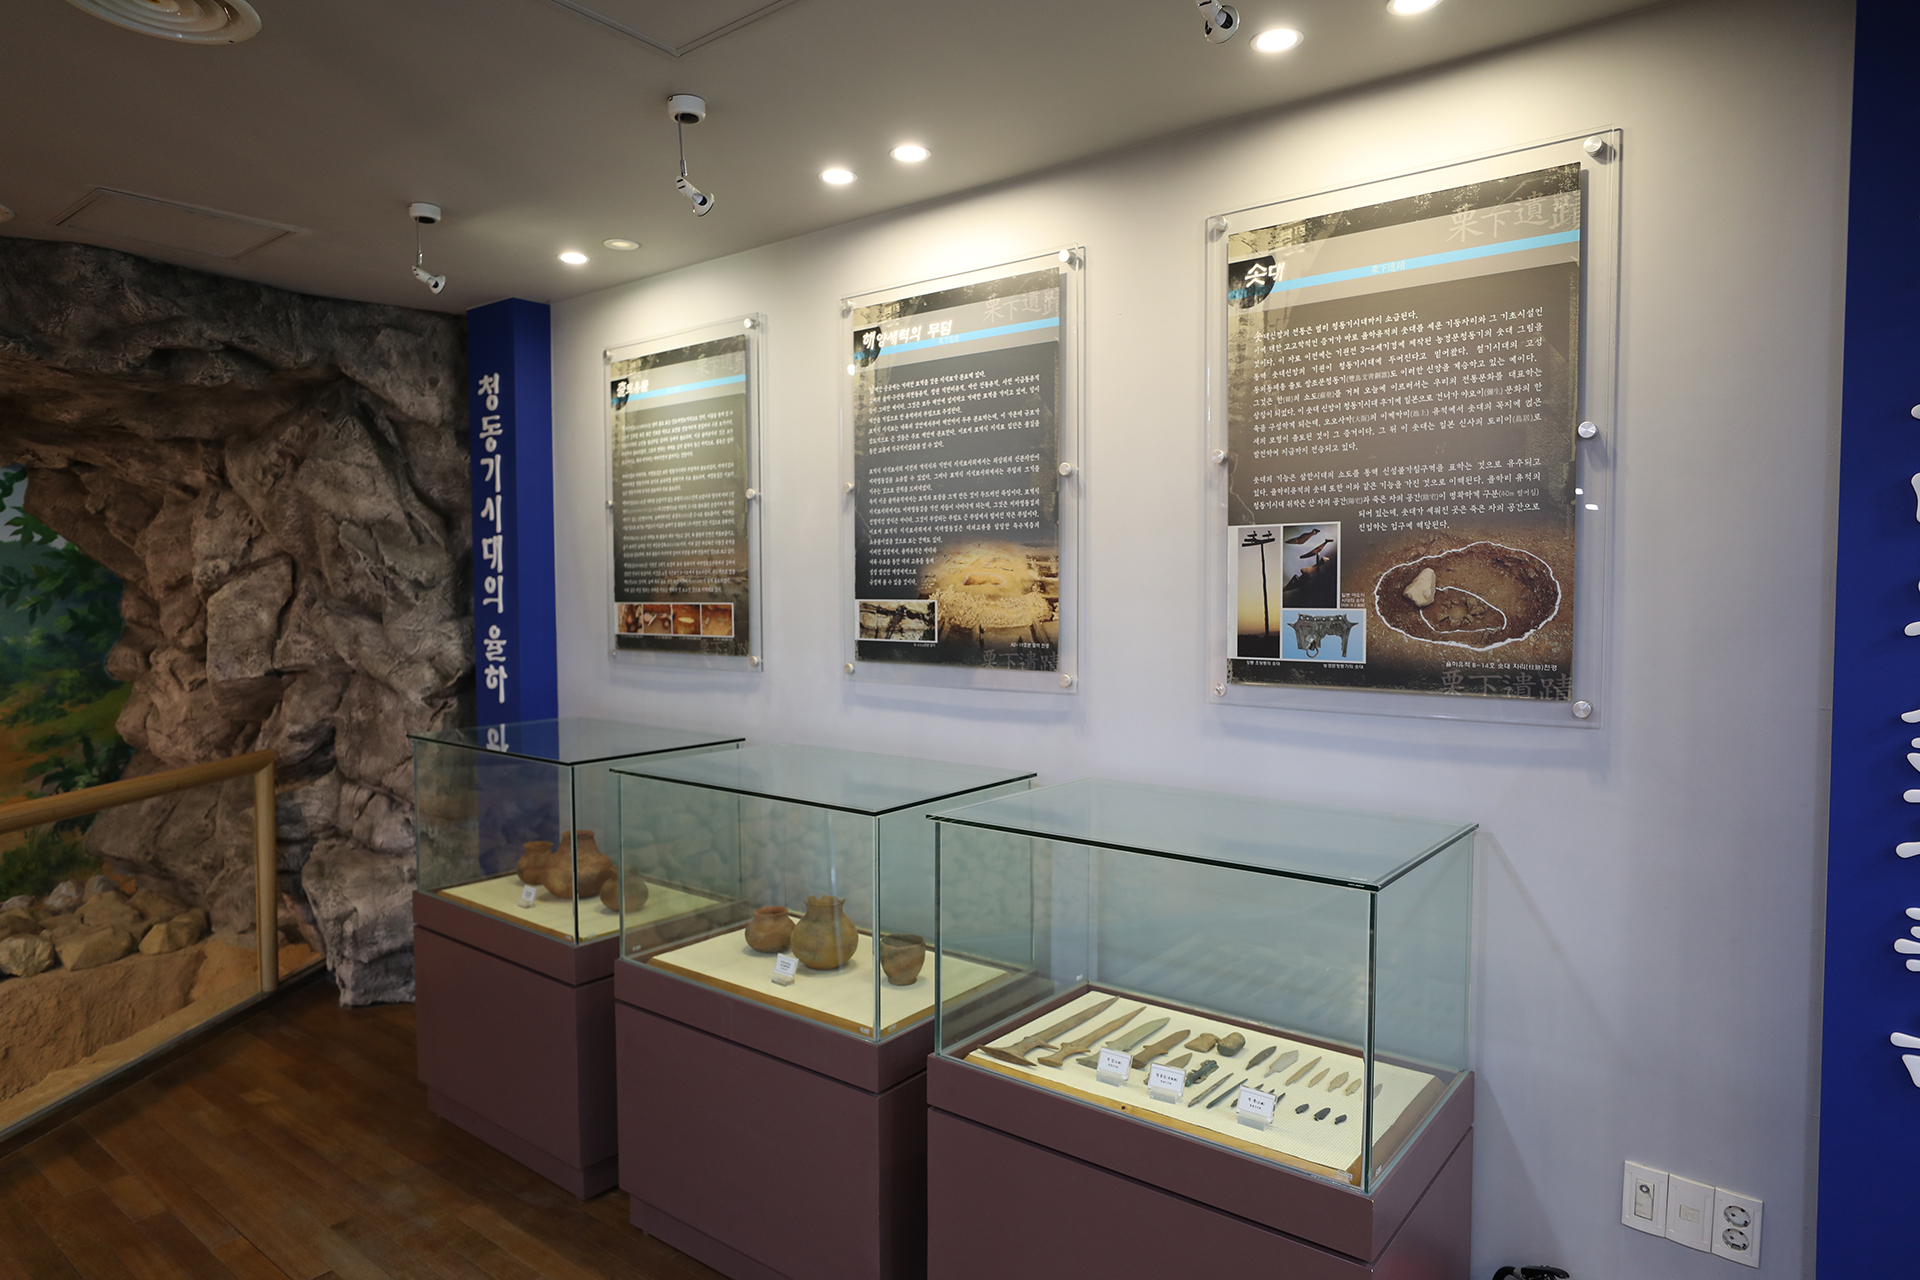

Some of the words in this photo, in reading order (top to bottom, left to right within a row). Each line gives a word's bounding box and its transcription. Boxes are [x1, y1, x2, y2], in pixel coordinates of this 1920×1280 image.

[1244, 262, 1284, 288] 솟대
[862, 326, 922, 351] 해양세력의
[927, 320, 953, 339] 무덤
[1252, 328, 1290, 343] 솟대신앙의
[1291, 325, 1313, 337] 전통은
[1314, 322, 1329, 334] 멀리
[1331, 314, 1382, 331] 청동기시대까지
[1384, 309, 1419, 323] 소급된다.
[1253, 345, 1267, 355] 이에
[1268, 342, 1283, 353] 대한
[1283, 337, 1318, 351] 고고학적인
[1319, 333, 1342, 346] 증거가
[1343, 332, 1359, 343] 바로
[1360, 326, 1398, 341] 율하유적의
[1400, 322, 1424, 335] 솟대를
[1426, 320, 1443, 331] 세운
[1444, 313, 1487, 329] 기둥자리와
[1488, 313, 1498, 323] 그
[1499, 305, 1543, 321] 기초시설인
[1253, 356, 1276, 369] 것이다.
[1277, 355, 1285, 365] 이
[1287, 353, 1302, 364] 자료
[1303, 349, 1333, 361] 이전에는
[1334, 345, 1357, 357] 기원전
[1408, 335, 1432, 348] 제작된
[1434, 327, 1492, 345] 농경문청동기의
[1495, 324, 1513, 337] 솟대
[1516, 321, 1544, 334] 그림을
[1271, 365, 1306, 379] 솟대신앙의
[1310, 362, 1332, 374] 기원이
[1338, 356, 1382, 371] 청동기시대에
[1387, 351, 1427, 364] 두어진다고
[1476, 339, 1518, 354] 철기시대의
[1524, 335, 1543, 348] 고성
[1252, 396, 1273, 407] 그것은
[1363, 383, 1386, 395] 오늘에
[1389, 379, 1429, 392] 이르러서는
[1432, 375, 1457, 387] 우리의
[1461, 370, 1503, 385] 전통문화를
[1507, 366, 1543, 379] 대표하는
[1287, 380, 1303, 390] 출토
[1399, 364, 1424, 377] 이러한
[1425, 362, 1450, 375] 신앙을
[1452, 358, 1486, 371] 계승하고
[1488, 356, 1506, 367] 있는
[1508, 352, 1538, 365] 예이다.
[1252, 409, 1273, 420] 상징이
[1273, 406, 1296, 418] 되었다.
[1296, 405, 1304, 415] 이
[1305, 404, 1320, 415] 솟대
[1320, 401, 1342, 413] 신앙이
[1343, 397, 1378, 411] 청동기시대
[1379, 395, 1402, 407] 후기에
[1403, 393, 1434, 405] 일본으로
[1435, 389, 1459, 402] 건너가
[1503, 382, 1530, 395] 문화의
[1533, 381, 1543, 392] 한
[1267, 419, 1296, 432] 구성하게
[1431, 403, 1464, 416] 유적에서
[1466, 400, 1492, 413] 솟대의
[1252, 435, 1266, 446] 새의
[1268, 433, 1289, 444] 모형이
[1291, 431, 1313, 443] 출토된
[1315, 429, 1330, 441] 것이
[1332, 430, 1341, 439] 그
[1342, 425, 1375, 438] 증거이다.
[1377, 426, 1387, 435] 그
[1388, 423, 1397, 434] 뒤
[1400, 422, 1408, 433] 이
[1411, 421, 1436, 433] 솟대는
[1438, 419, 1456, 430] 일본
[1458, 416, 1483, 428] 신사의
[1252, 447, 1279, 459] 발전하여
[1281, 445, 1309, 457] 지금까지
[1311, 443, 1339, 455] 전승되고
[1341, 441, 1359, 452] 있다.
[1252, 474, 1273, 485] 솟대의
[1275, 472, 1297, 483] 기능은
[1299, 469, 1334, 482] 삼한시대의
[1337, 468, 1360, 479] 소도를
[1476, 459, 1503, 470] 것으로
[1506, 456, 1542, 468] 유추되고
[1252, 487, 1269, 497] 있다.
[1269, 484, 1311, 497] 율하리유적의
[1312, 483, 1327, 494] 솟대
[1328, 482, 1344, 493] 또한
[1345, 481, 1361, 492] 이와
[1362, 480, 1377, 491] 같은
[1378, 479, 1402, 490] 기능을
[1403, 477, 1420, 489] 가진
[1422, 477, 1447, 488] 것으로
[1448, 474, 1484, 486] 이해된다.
[1486, 472, 1512, 484] 율하리
[1514, 470, 1541, 483] 유적의
[477, 373, 504, 614] 청동기시대의
[1252, 499, 1285, 511] 청동기시대
[1307, 497, 1316, 508] 산
[1316, 496, 1331, 507] 자의
[1371, 494, 1387, 504] 죽은
[1388, 492, 1404, 503] 자의
[1448, 489, 1480, 501] 명확하게
[1357, 508, 1373, 518] 되어
[1400, 505, 1425, 517] 솟대가
[1425, 504, 1449, 516] 세워진
[1450, 504, 1468, 515] 곳은
[1468, 503, 1486, 514] 죽은
[1487, 502, 1504, 513] 자의
[1506, 501, 1541, 513] 공간으로
[1358, 521, 1388, 533] 진입하는
[1390, 520, 1413, 531] 입구에
[1415, 519, 1450, 530] 해당된다.
[483, 625, 509, 704] 율하
